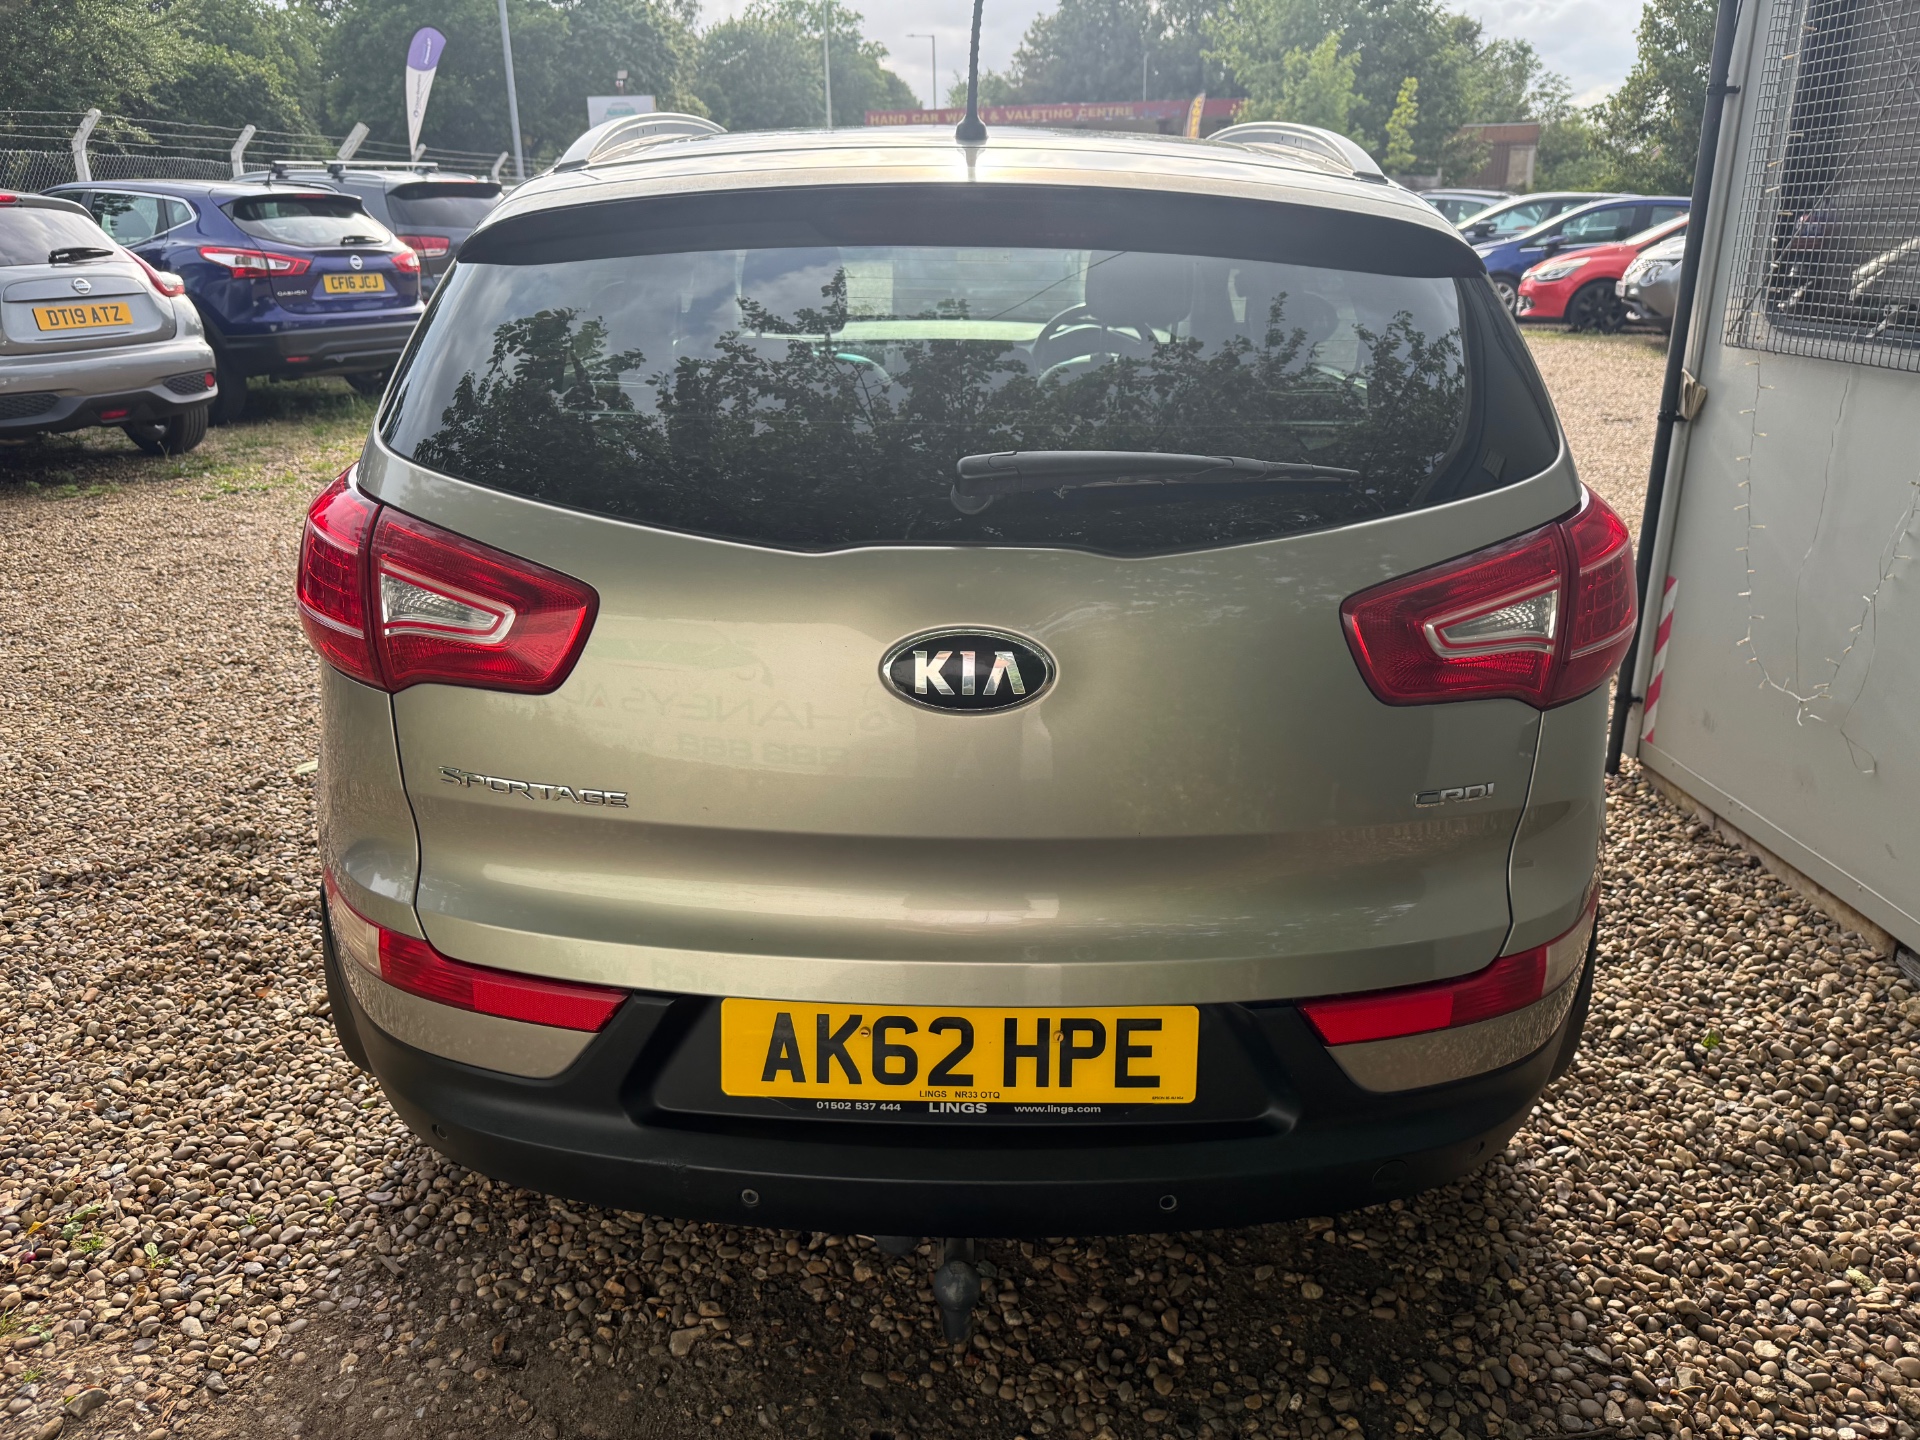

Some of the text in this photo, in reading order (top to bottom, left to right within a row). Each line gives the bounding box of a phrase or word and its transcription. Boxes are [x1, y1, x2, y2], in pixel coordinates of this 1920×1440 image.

[869, 114, 908, 126] HAND
[911, 113, 940, 123] CAR
[988, 111, 1000, 121] &
[1005, 108, 1073, 121] VALETING
[1078, 106, 1134, 118] CENTRE
[331, 275, 379, 289] CF16 JCJ
[46, 306, 123, 326] DT19 ATZ
[913, 651, 1026, 695] KIA
[438, 766, 629, 808] SPORTAGE
[761, 1012, 1163, 1088] AK62 HPE
[919, 1090, 947, 1098] LINGS
[954, 1091, 978, 1099] NR33
[816, 1101, 902, 1112] 01502 537 444
[928, 1102, 988, 1114] LINGS
[1014, 1105, 1101, 1115] www.lings.com
